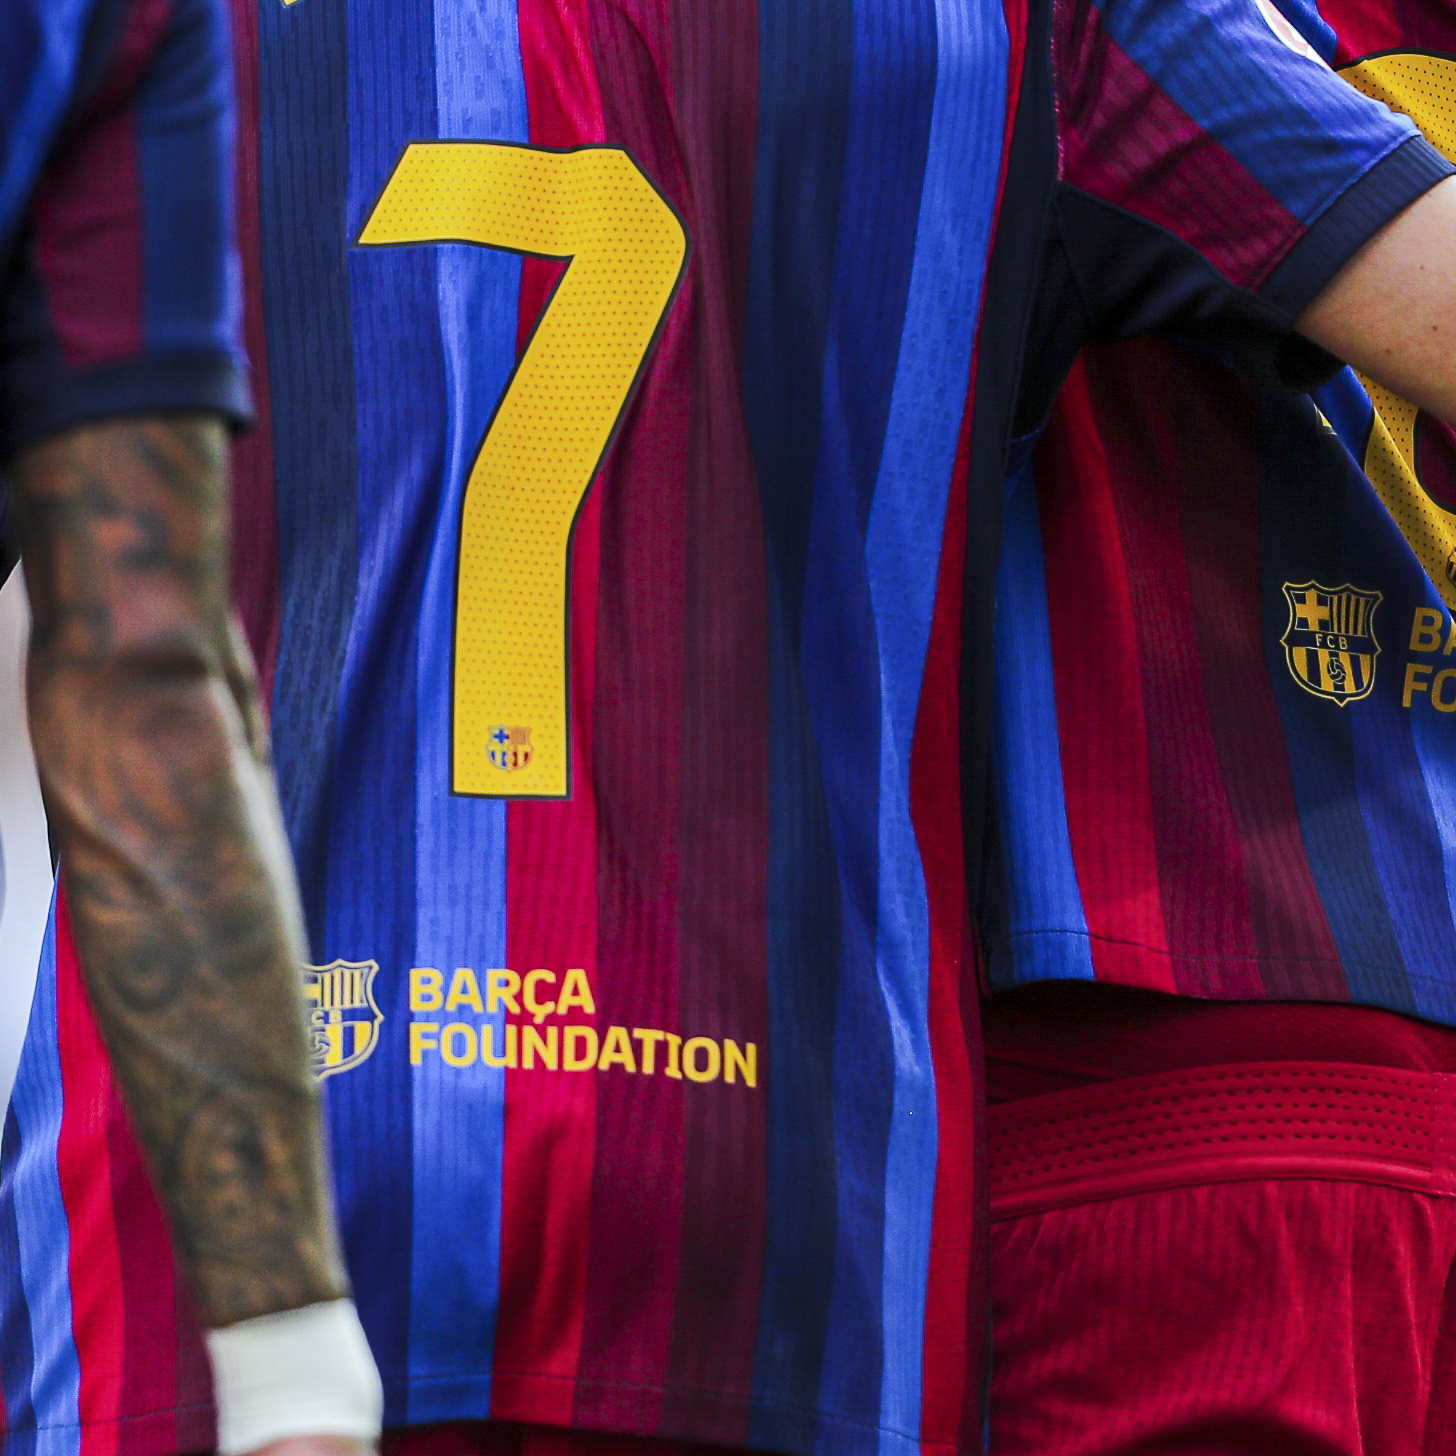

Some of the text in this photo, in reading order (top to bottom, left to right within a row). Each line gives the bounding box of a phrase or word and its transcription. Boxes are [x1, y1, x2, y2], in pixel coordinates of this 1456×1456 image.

[354, 140, 691, 799] 7
[1315, 634, 1348, 651] FCB
[409, 967, 596, 1024] BARÇA
[409, 1021, 758, 1088] FOUNDATION
